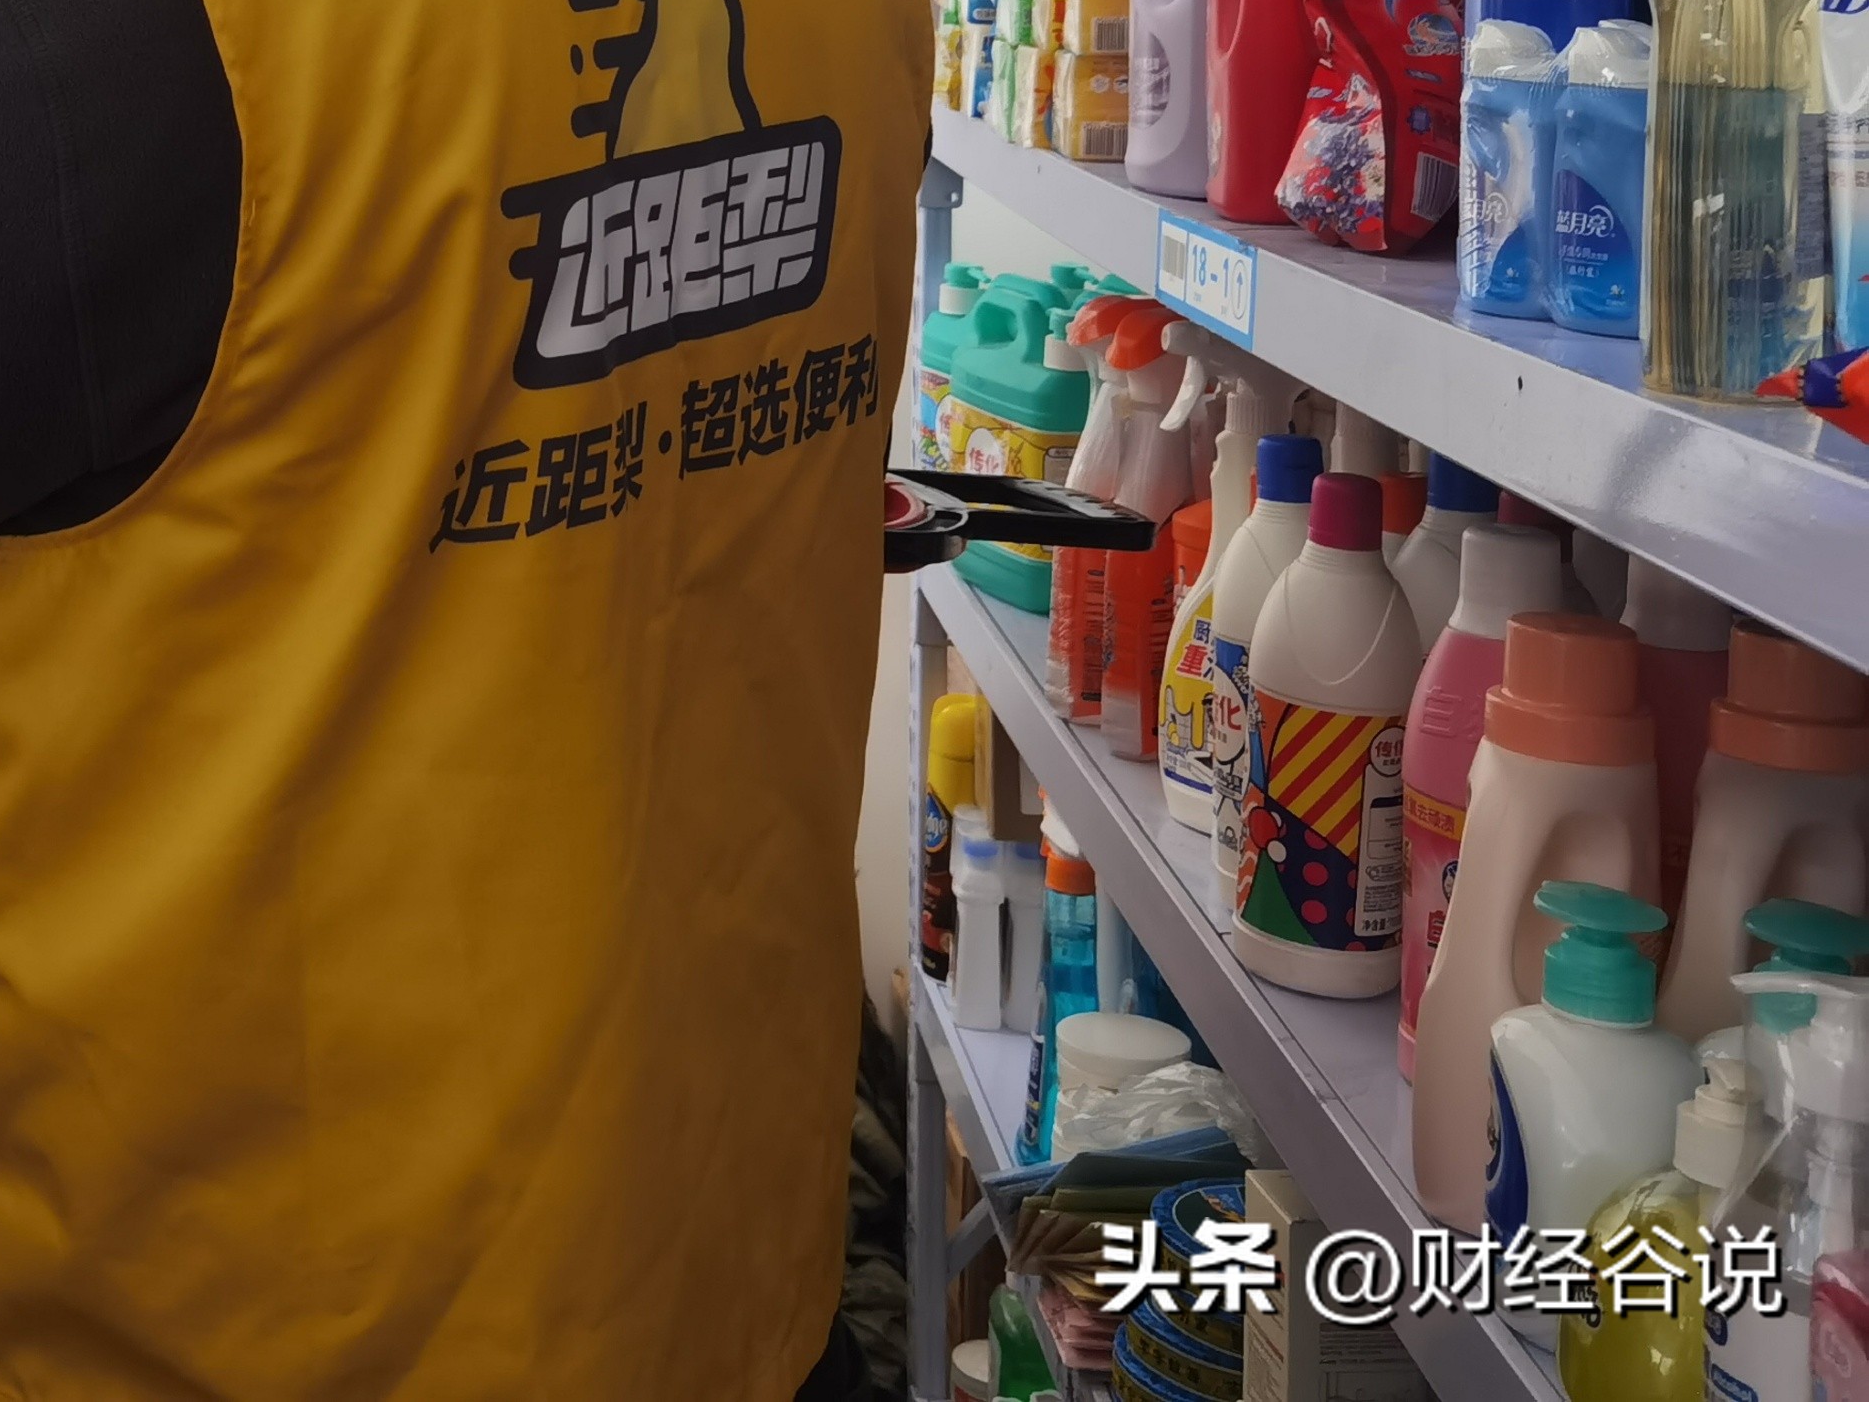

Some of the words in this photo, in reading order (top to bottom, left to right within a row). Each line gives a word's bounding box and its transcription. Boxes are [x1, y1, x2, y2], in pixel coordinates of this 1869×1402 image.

[1556, 204, 1614, 238] 蓝月亮
[536, 140, 826, 359] 近距梨
[1191, 246, 1229, 298] 18-1
[970, 448, 1000, 474] 传化
